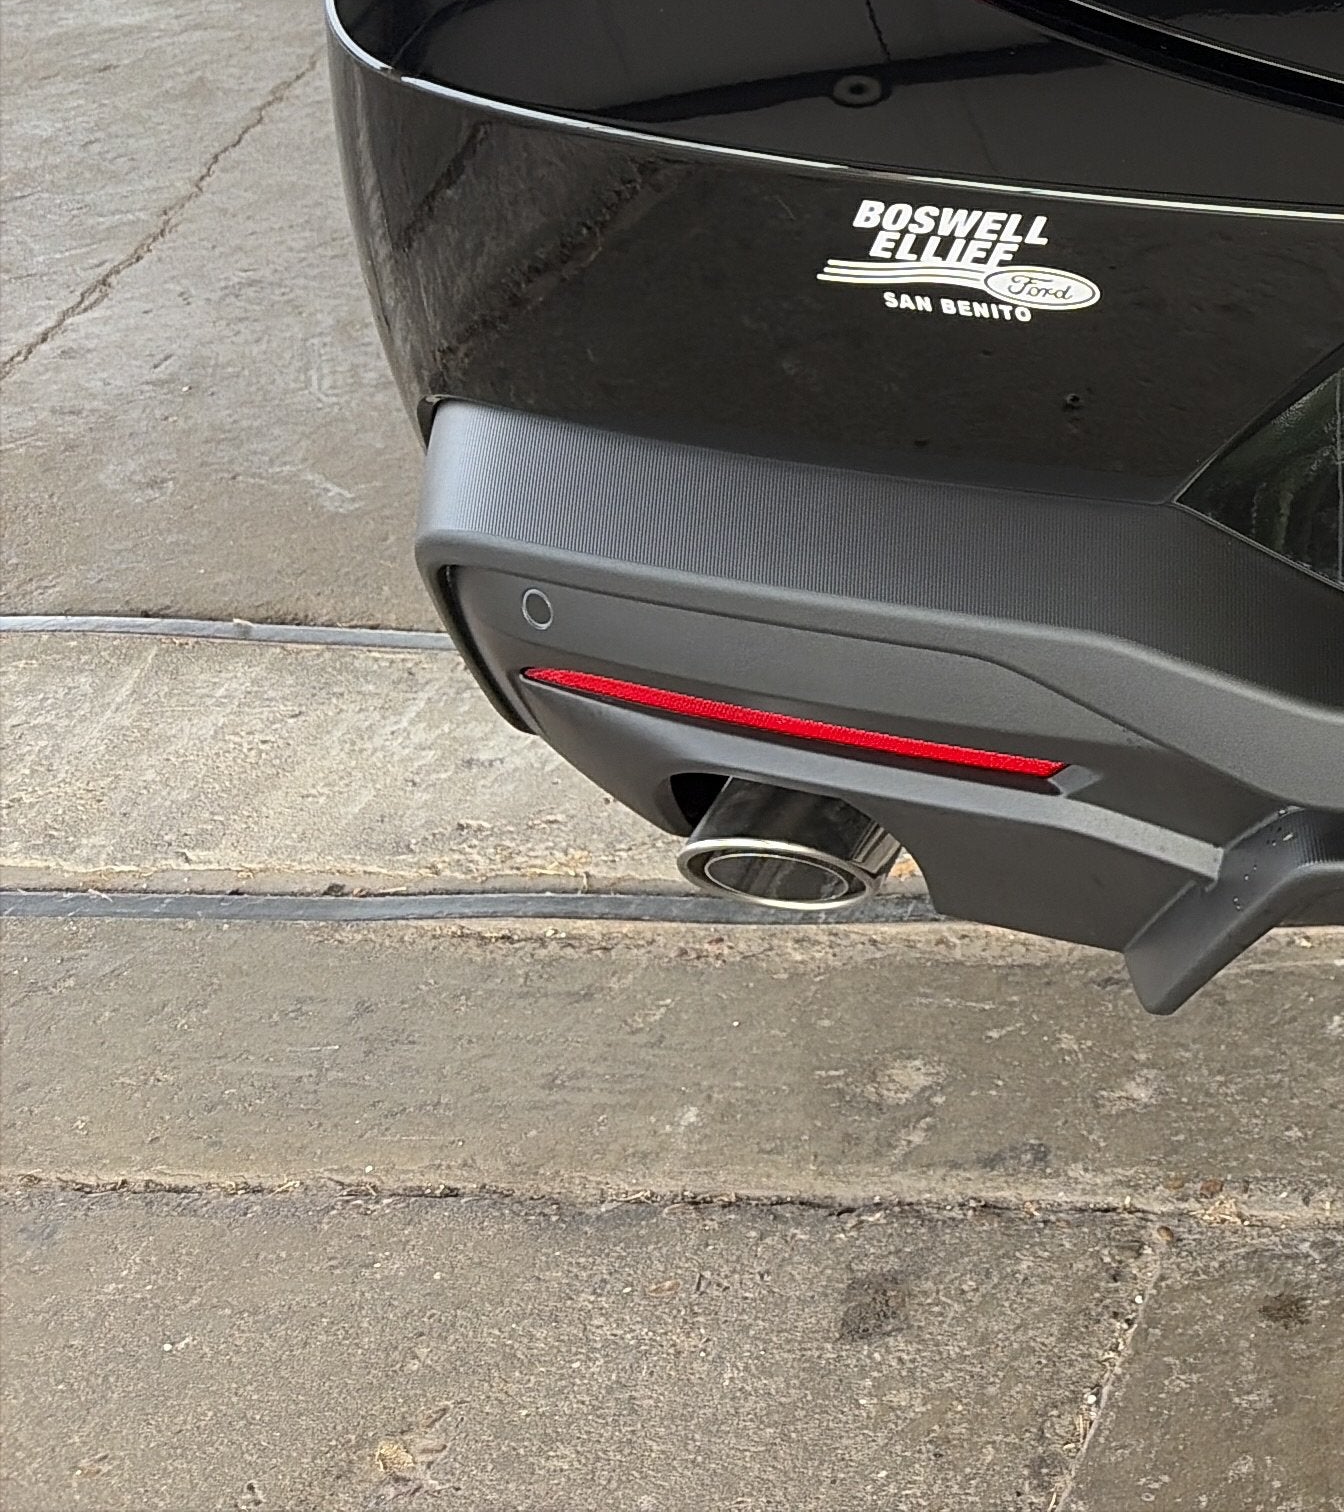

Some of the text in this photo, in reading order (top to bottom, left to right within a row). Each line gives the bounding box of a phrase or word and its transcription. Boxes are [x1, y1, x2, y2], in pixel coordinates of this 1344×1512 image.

[852, 199, 1049, 246] BOSWELL
[868, 230, 1020, 267] ELLIFF
[1006, 274, 1076, 301] Ford
[883, 291, 1032, 322] SAN BENITO
